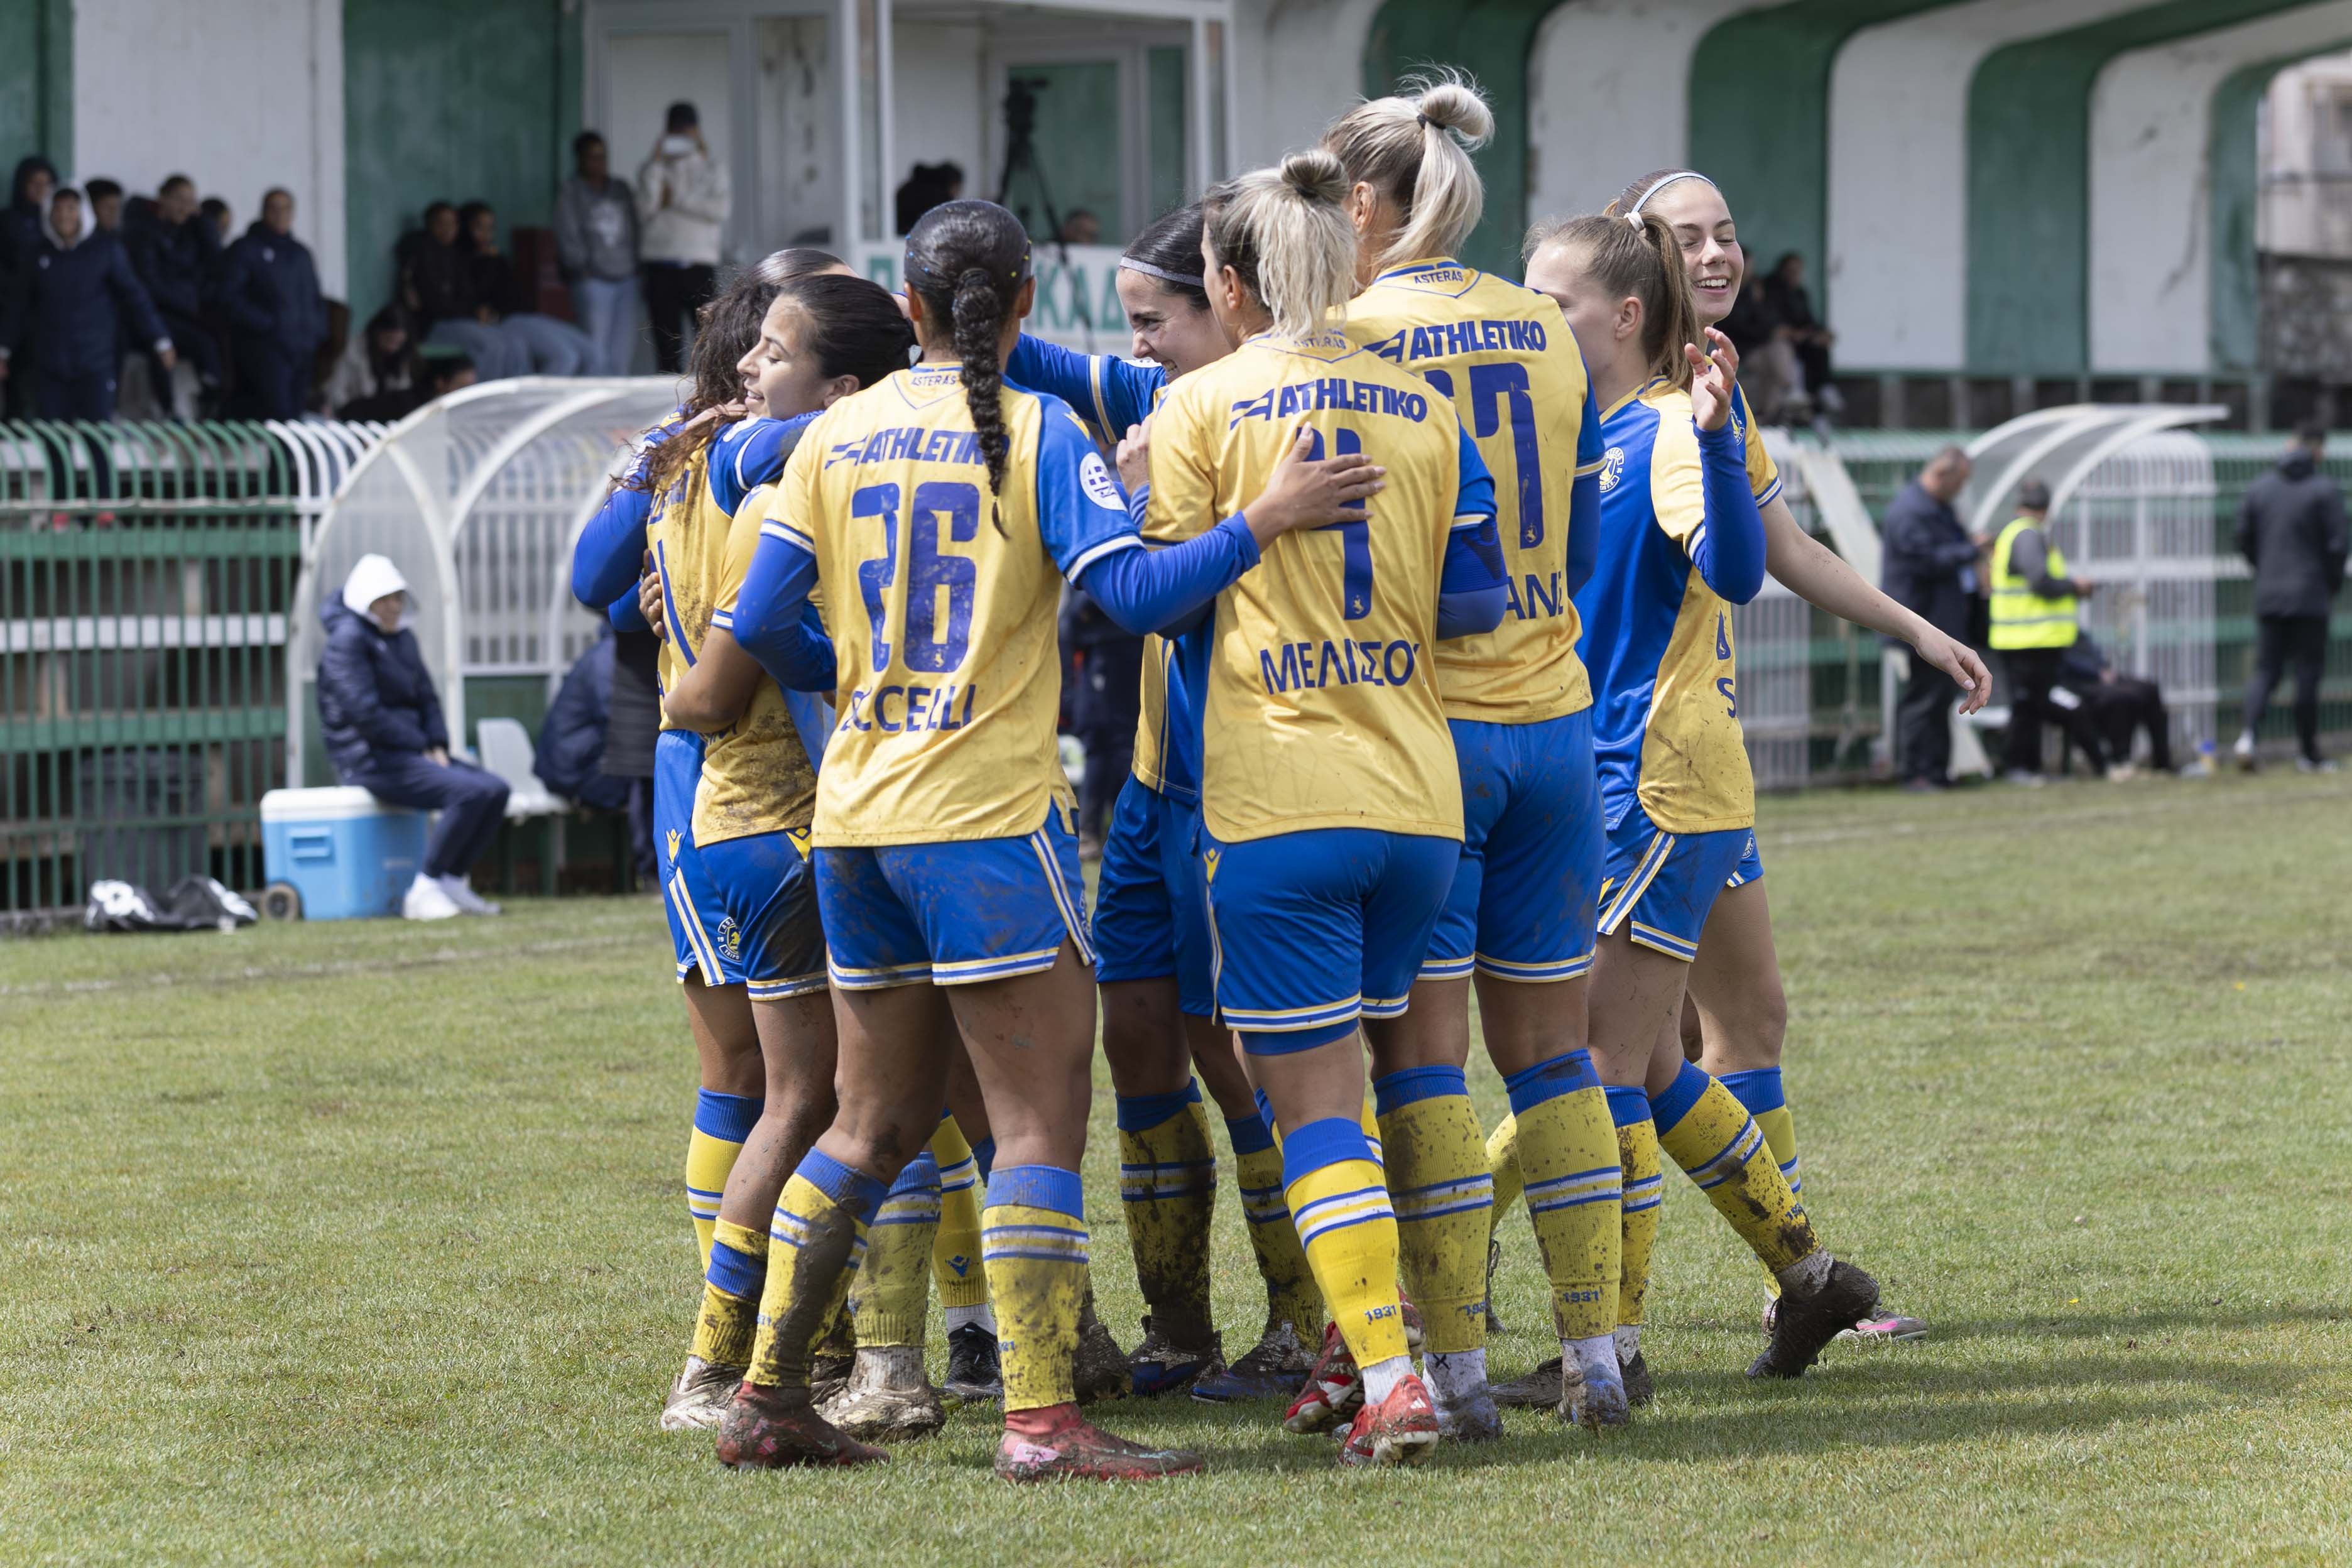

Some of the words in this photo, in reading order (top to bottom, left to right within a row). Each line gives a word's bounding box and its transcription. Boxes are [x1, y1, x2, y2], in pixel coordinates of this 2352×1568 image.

[1414, 270, 1463, 283] ASTERAS
[1409, 320, 1546, 361] ATHLETIKO
[1278, 378, 1427, 422] ATHLETIKO
[860, 427, 1010, 465] ATHLETIK
[1563, 1290, 1599, 1304] 1931
[1364, 1304, 1397, 1322] 1931
[1464, 1301, 1486, 1316] 193
